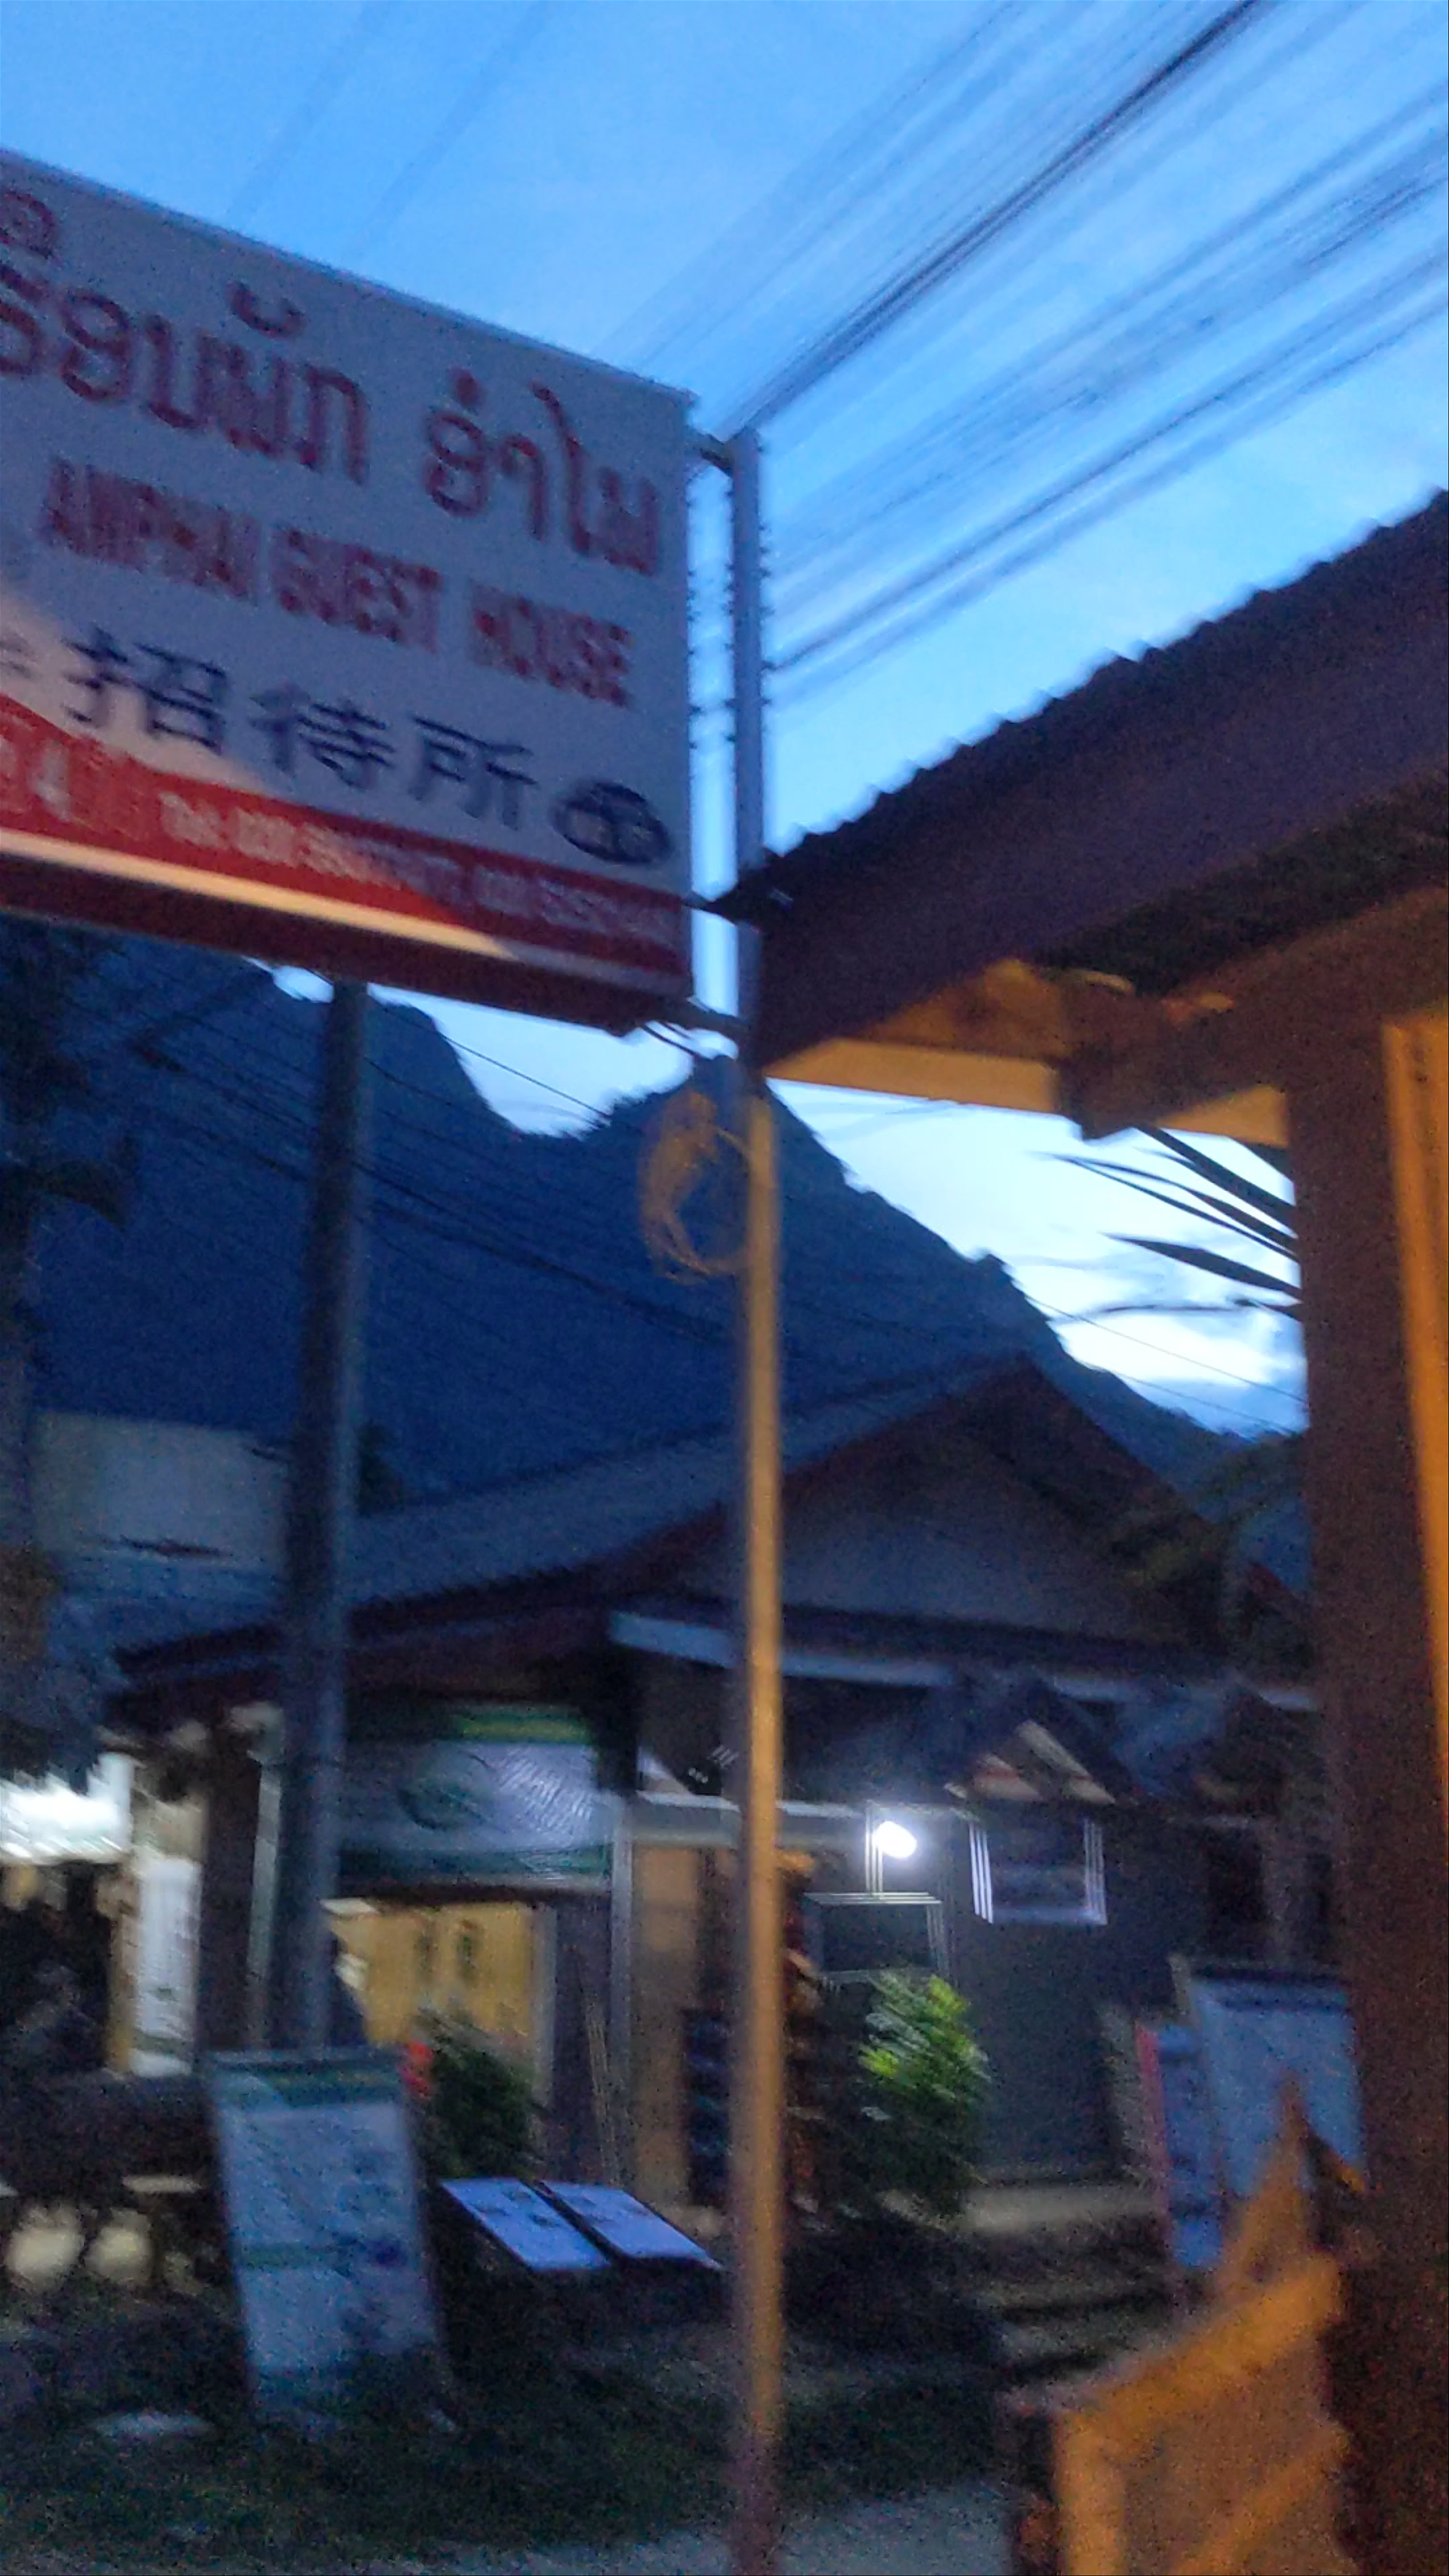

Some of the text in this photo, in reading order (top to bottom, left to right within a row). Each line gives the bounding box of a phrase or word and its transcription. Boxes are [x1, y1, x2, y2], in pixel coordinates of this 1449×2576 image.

[269, 524, 443, 653] GUEST
[468, 579, 633, 707] HOUSE
[0, 626, 538, 830] 招待所
